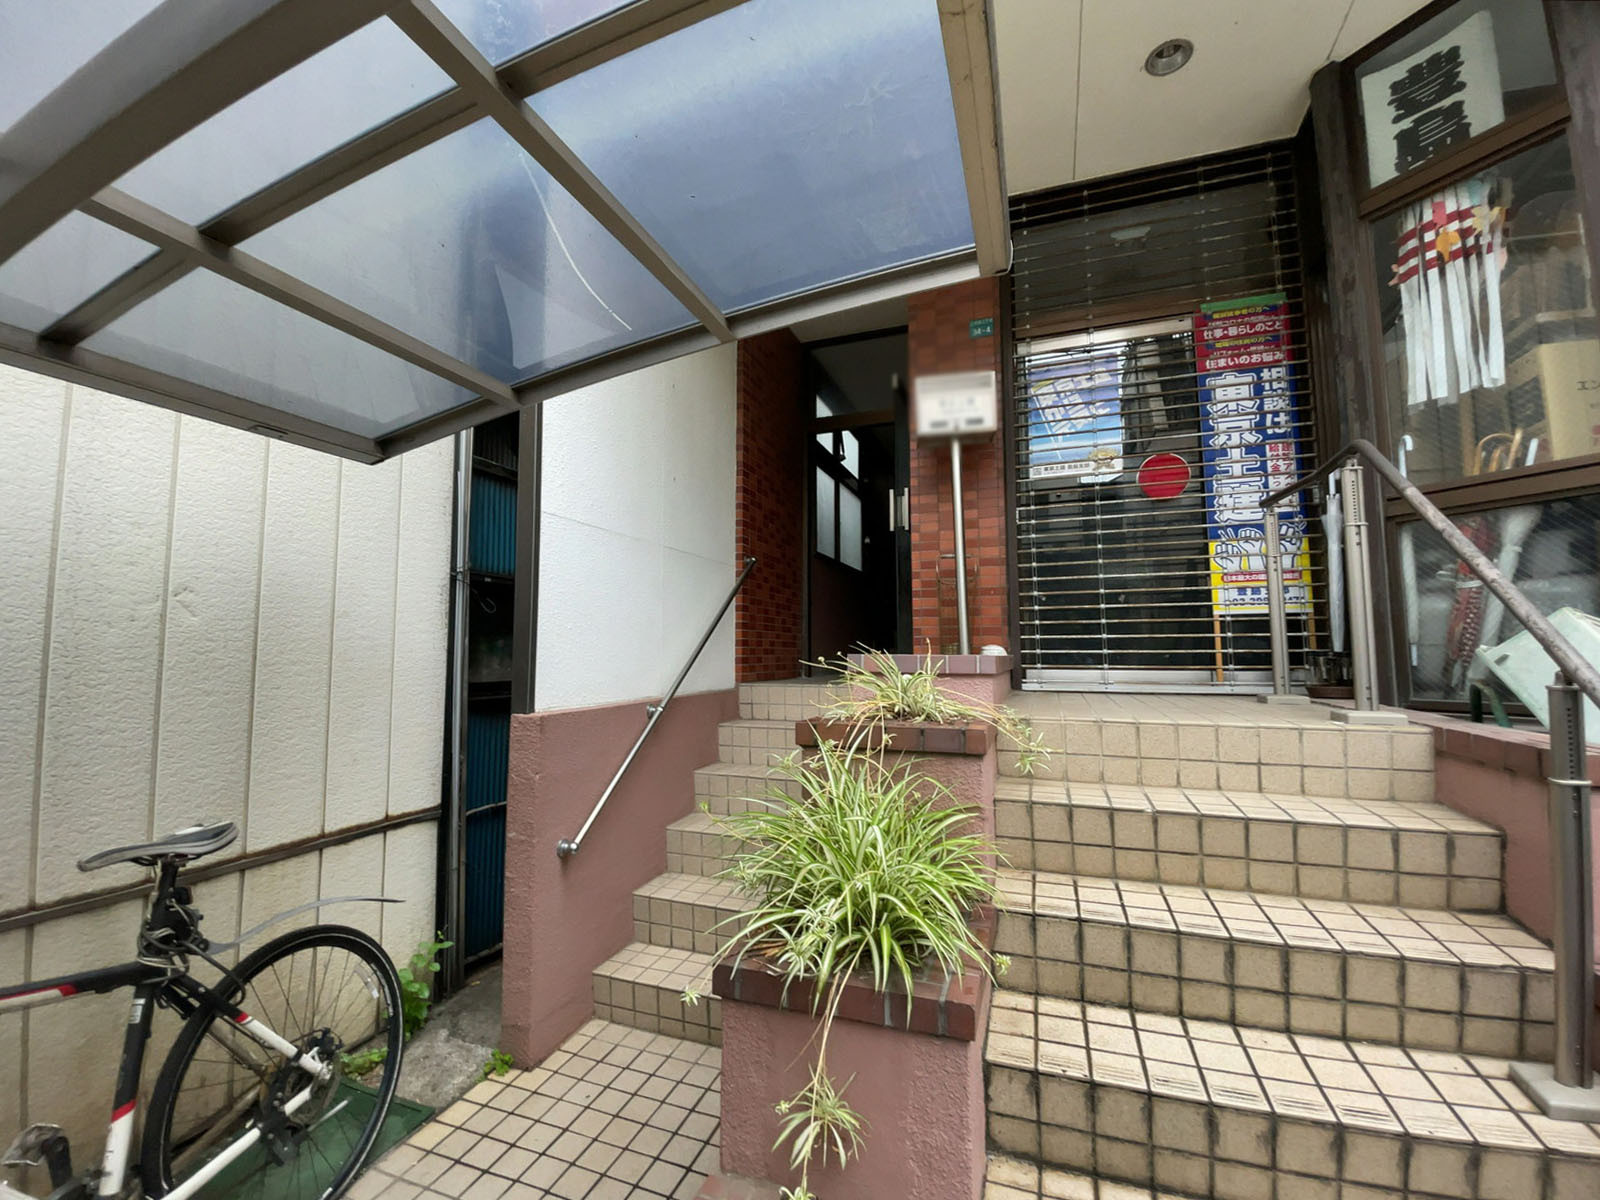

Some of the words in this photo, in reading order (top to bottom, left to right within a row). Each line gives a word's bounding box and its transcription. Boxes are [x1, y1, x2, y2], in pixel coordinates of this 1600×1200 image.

[1203, 321, 1283, 339] 仕事・暮らしのこと
[1206, 351, 1284, 369] 住まいのお悩み
[1261, 367, 1291, 434] 相談は
[1206, 372, 1266, 524] 東京土建
